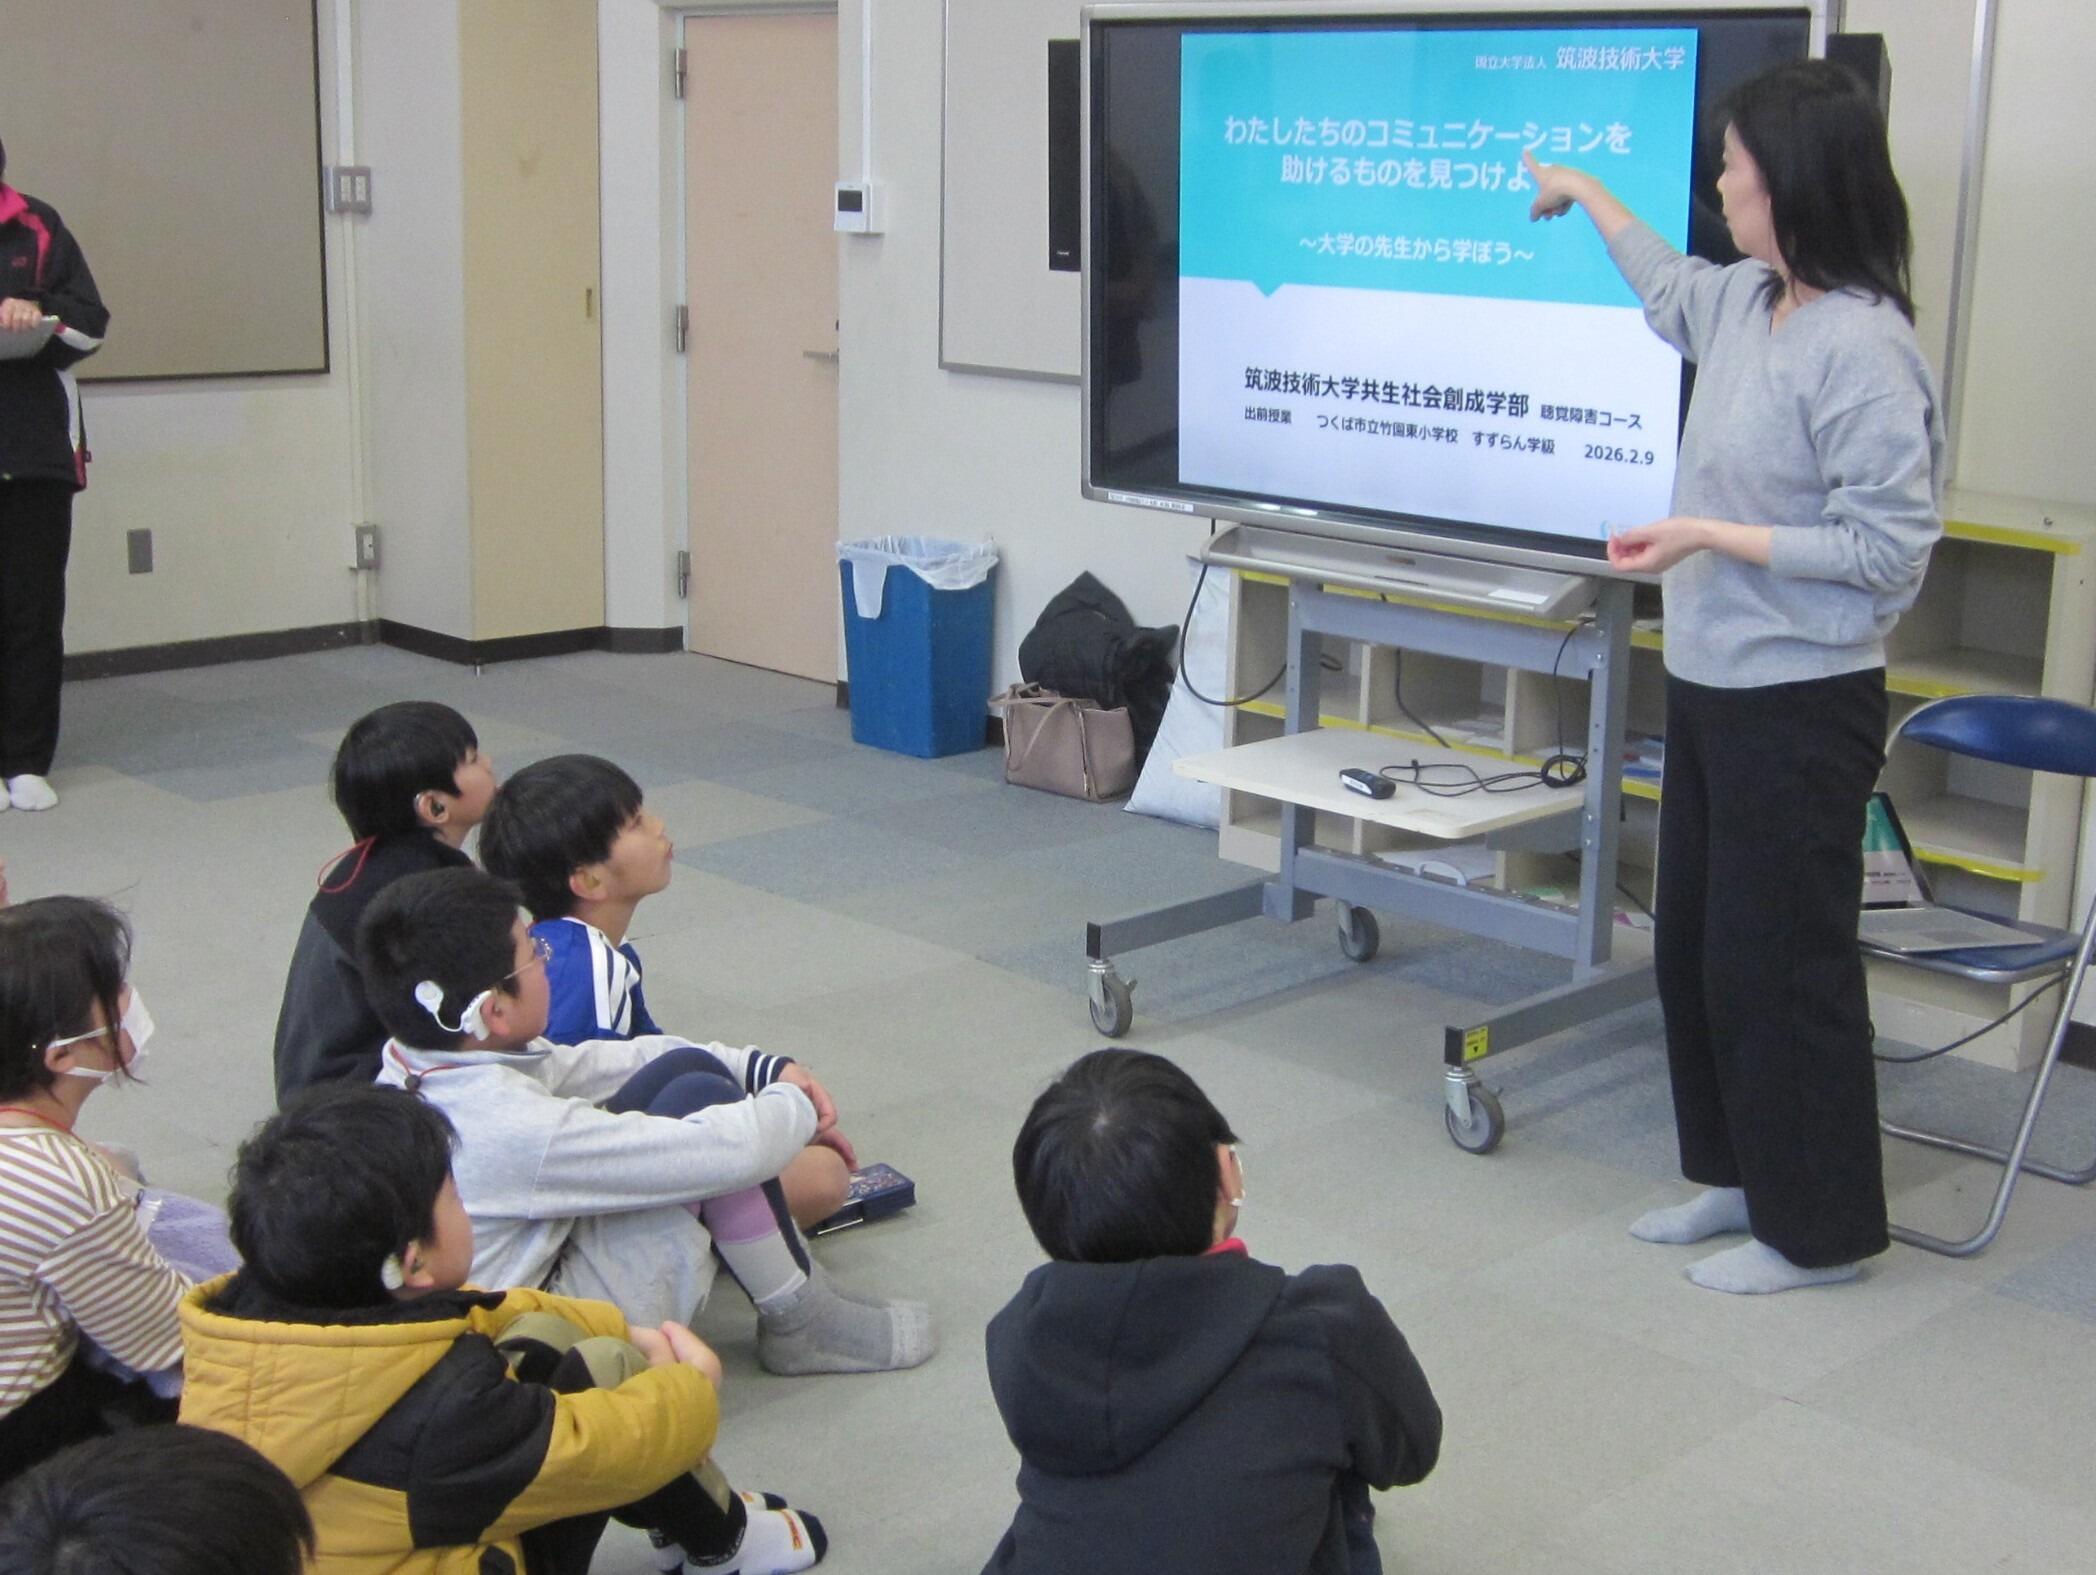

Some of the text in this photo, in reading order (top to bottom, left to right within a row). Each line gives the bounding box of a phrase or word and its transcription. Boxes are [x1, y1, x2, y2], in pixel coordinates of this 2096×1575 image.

[1556, 46, 1685, 71] 筑波技術大学
[1225, 116, 1632, 154] わたしたちのコミュニケーションを
[1281, 155, 1554, 192] 助けるものを見つけよ
[1245, 366, 1642, 429] 筑波技術大学共生社会創成学部 聴覚障害コース
[1244, 406, 1292, 424] 出前授業
[1472, 431, 1555, 455] すずらん学級
[1585, 444, 1654, 466] 2026.2.9
